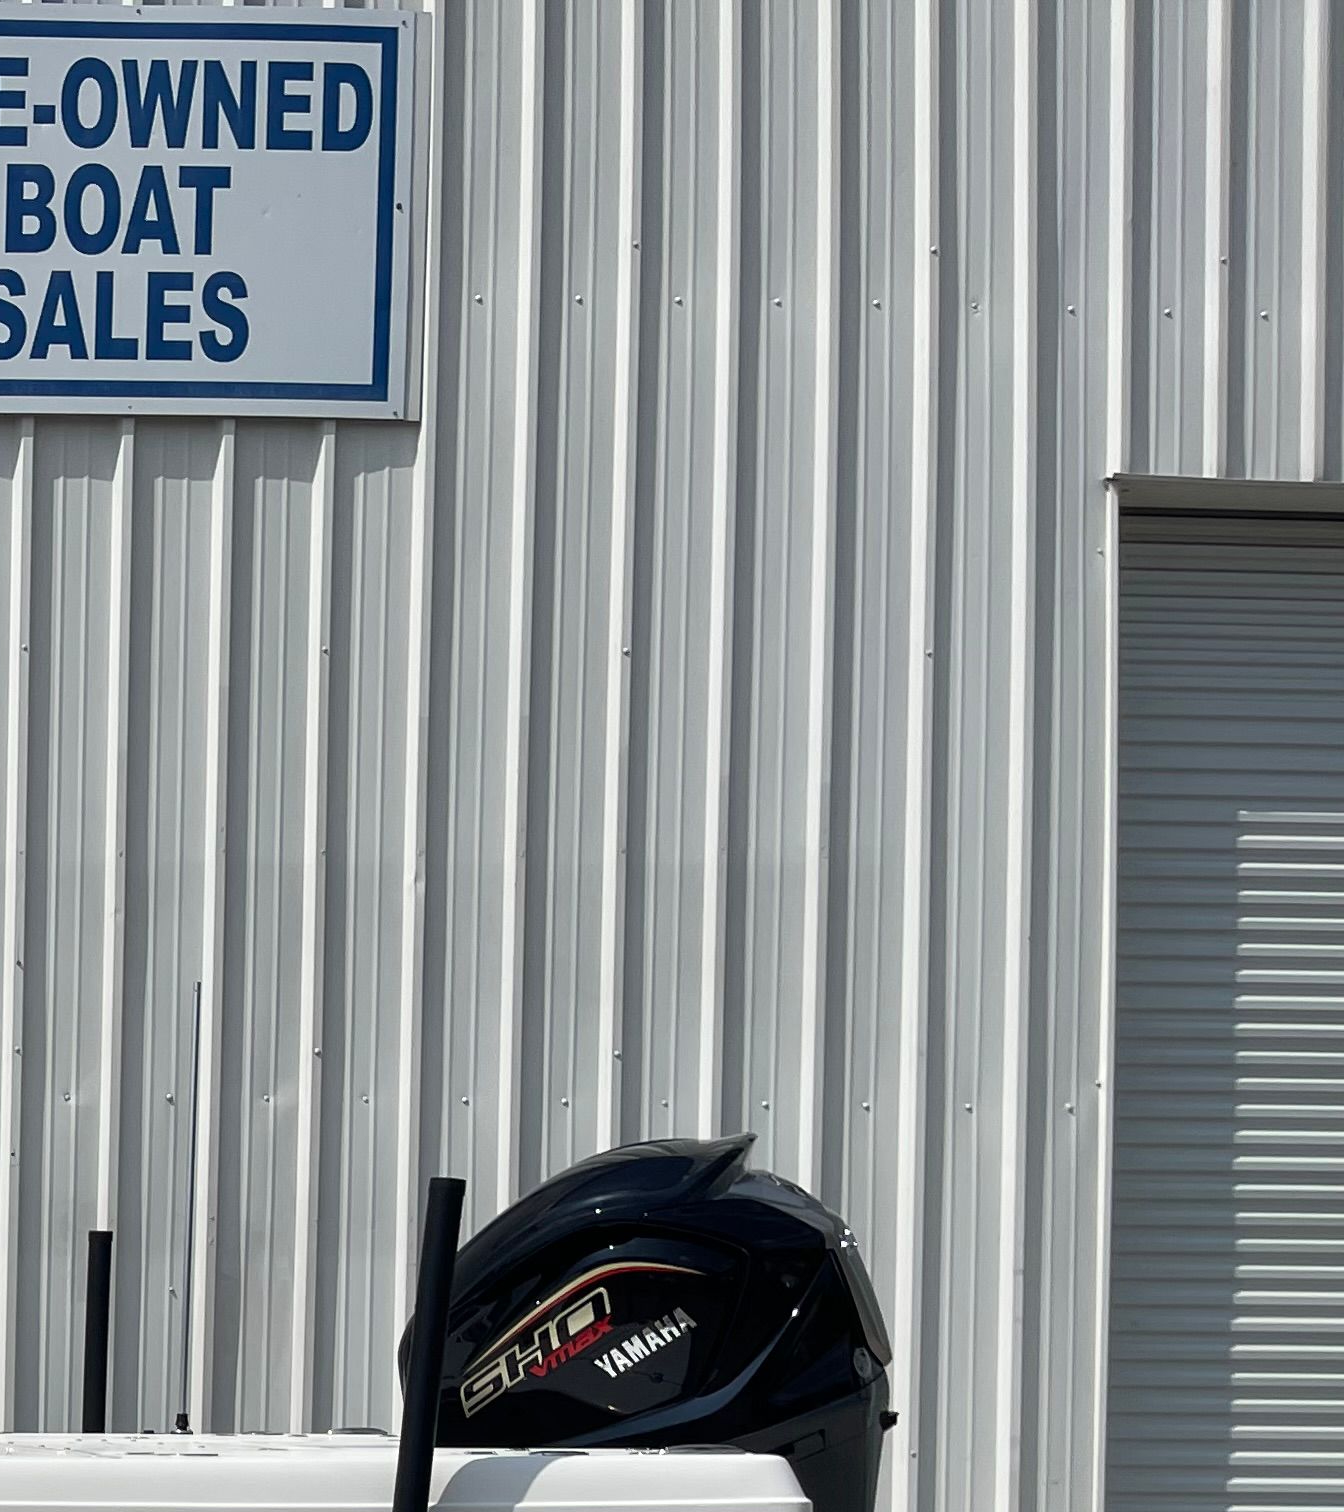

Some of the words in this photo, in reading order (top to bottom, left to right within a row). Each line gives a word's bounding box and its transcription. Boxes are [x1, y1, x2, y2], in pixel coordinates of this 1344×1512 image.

[4, 163, 232, 256] BOAT
[460, 1286, 612, 1419] SHO
[593, 1306, 699, 1379] YAMAHA
